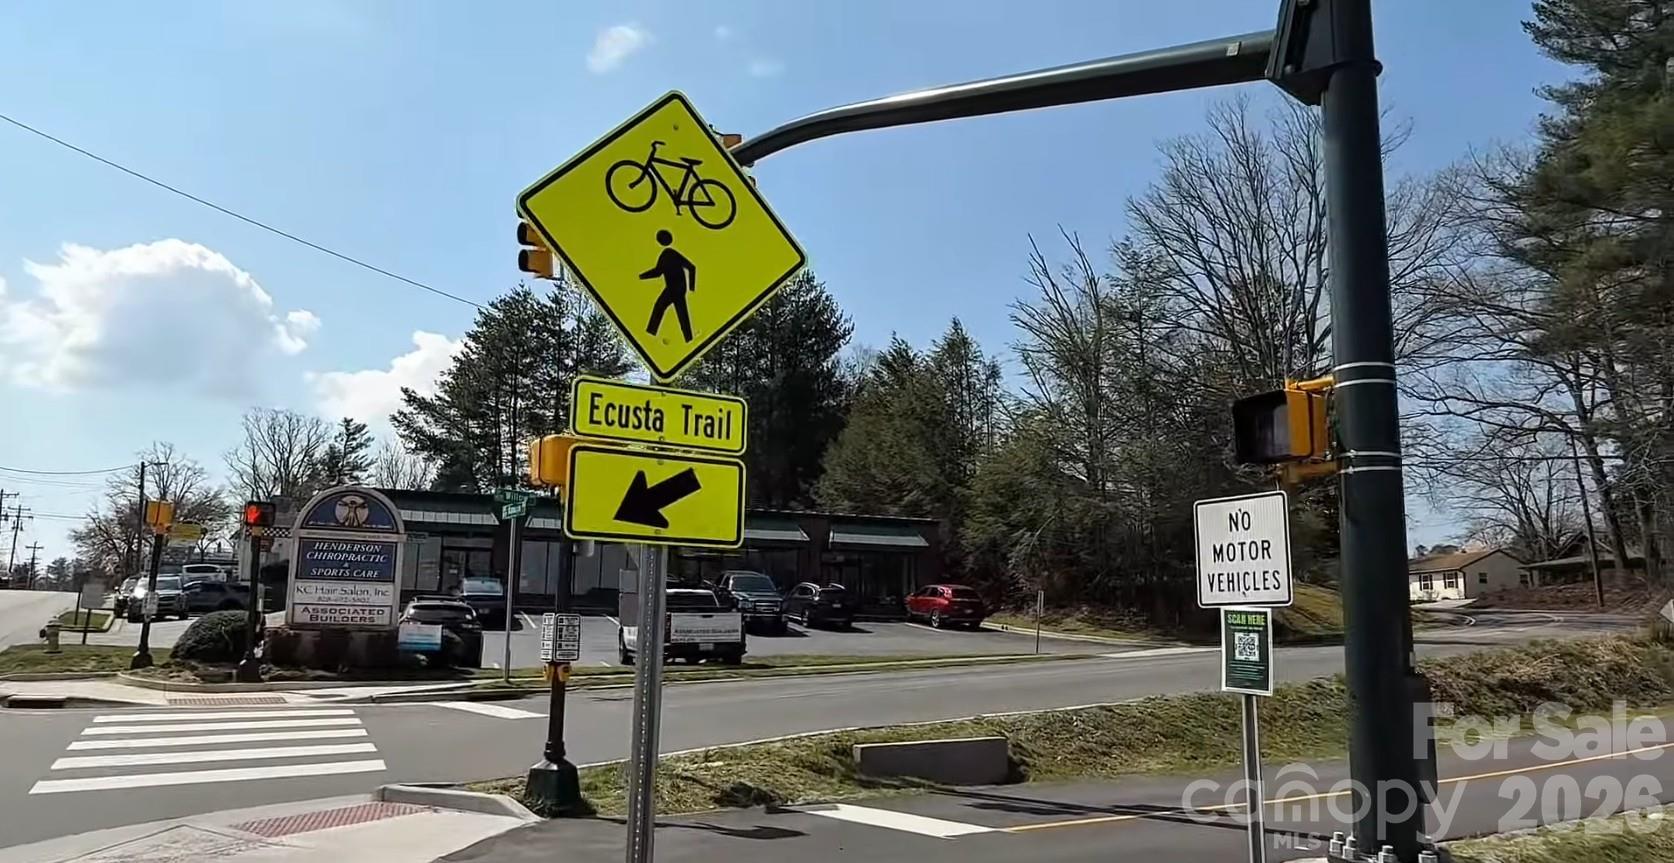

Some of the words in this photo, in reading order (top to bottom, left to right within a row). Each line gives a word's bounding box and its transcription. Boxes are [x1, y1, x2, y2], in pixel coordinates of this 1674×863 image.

[589, 392, 665, 433] Ecusta
[682, 404, 732, 440] Trail
[1228, 511, 1252, 532] NO
[313, 542, 382, 553] HENDERSON
[1212, 539, 1271, 563] MOTOR
[306, 551, 388, 563] CHIROPRACTIC
[310, 568, 351, 577] SPORTS
[353, 569, 380, 578] CARE
[1207, 570, 1281, 593] VEHICLES
[295, 585, 312, 595] KC
[315, 585, 338, 595] Hair
[301, 606, 385, 616] ASSOCIATED
[309, 614, 376, 623] BUILDERS
[1227, 613, 1247, 625] SCAN
[1247, 614, 1266, 626] HERE
